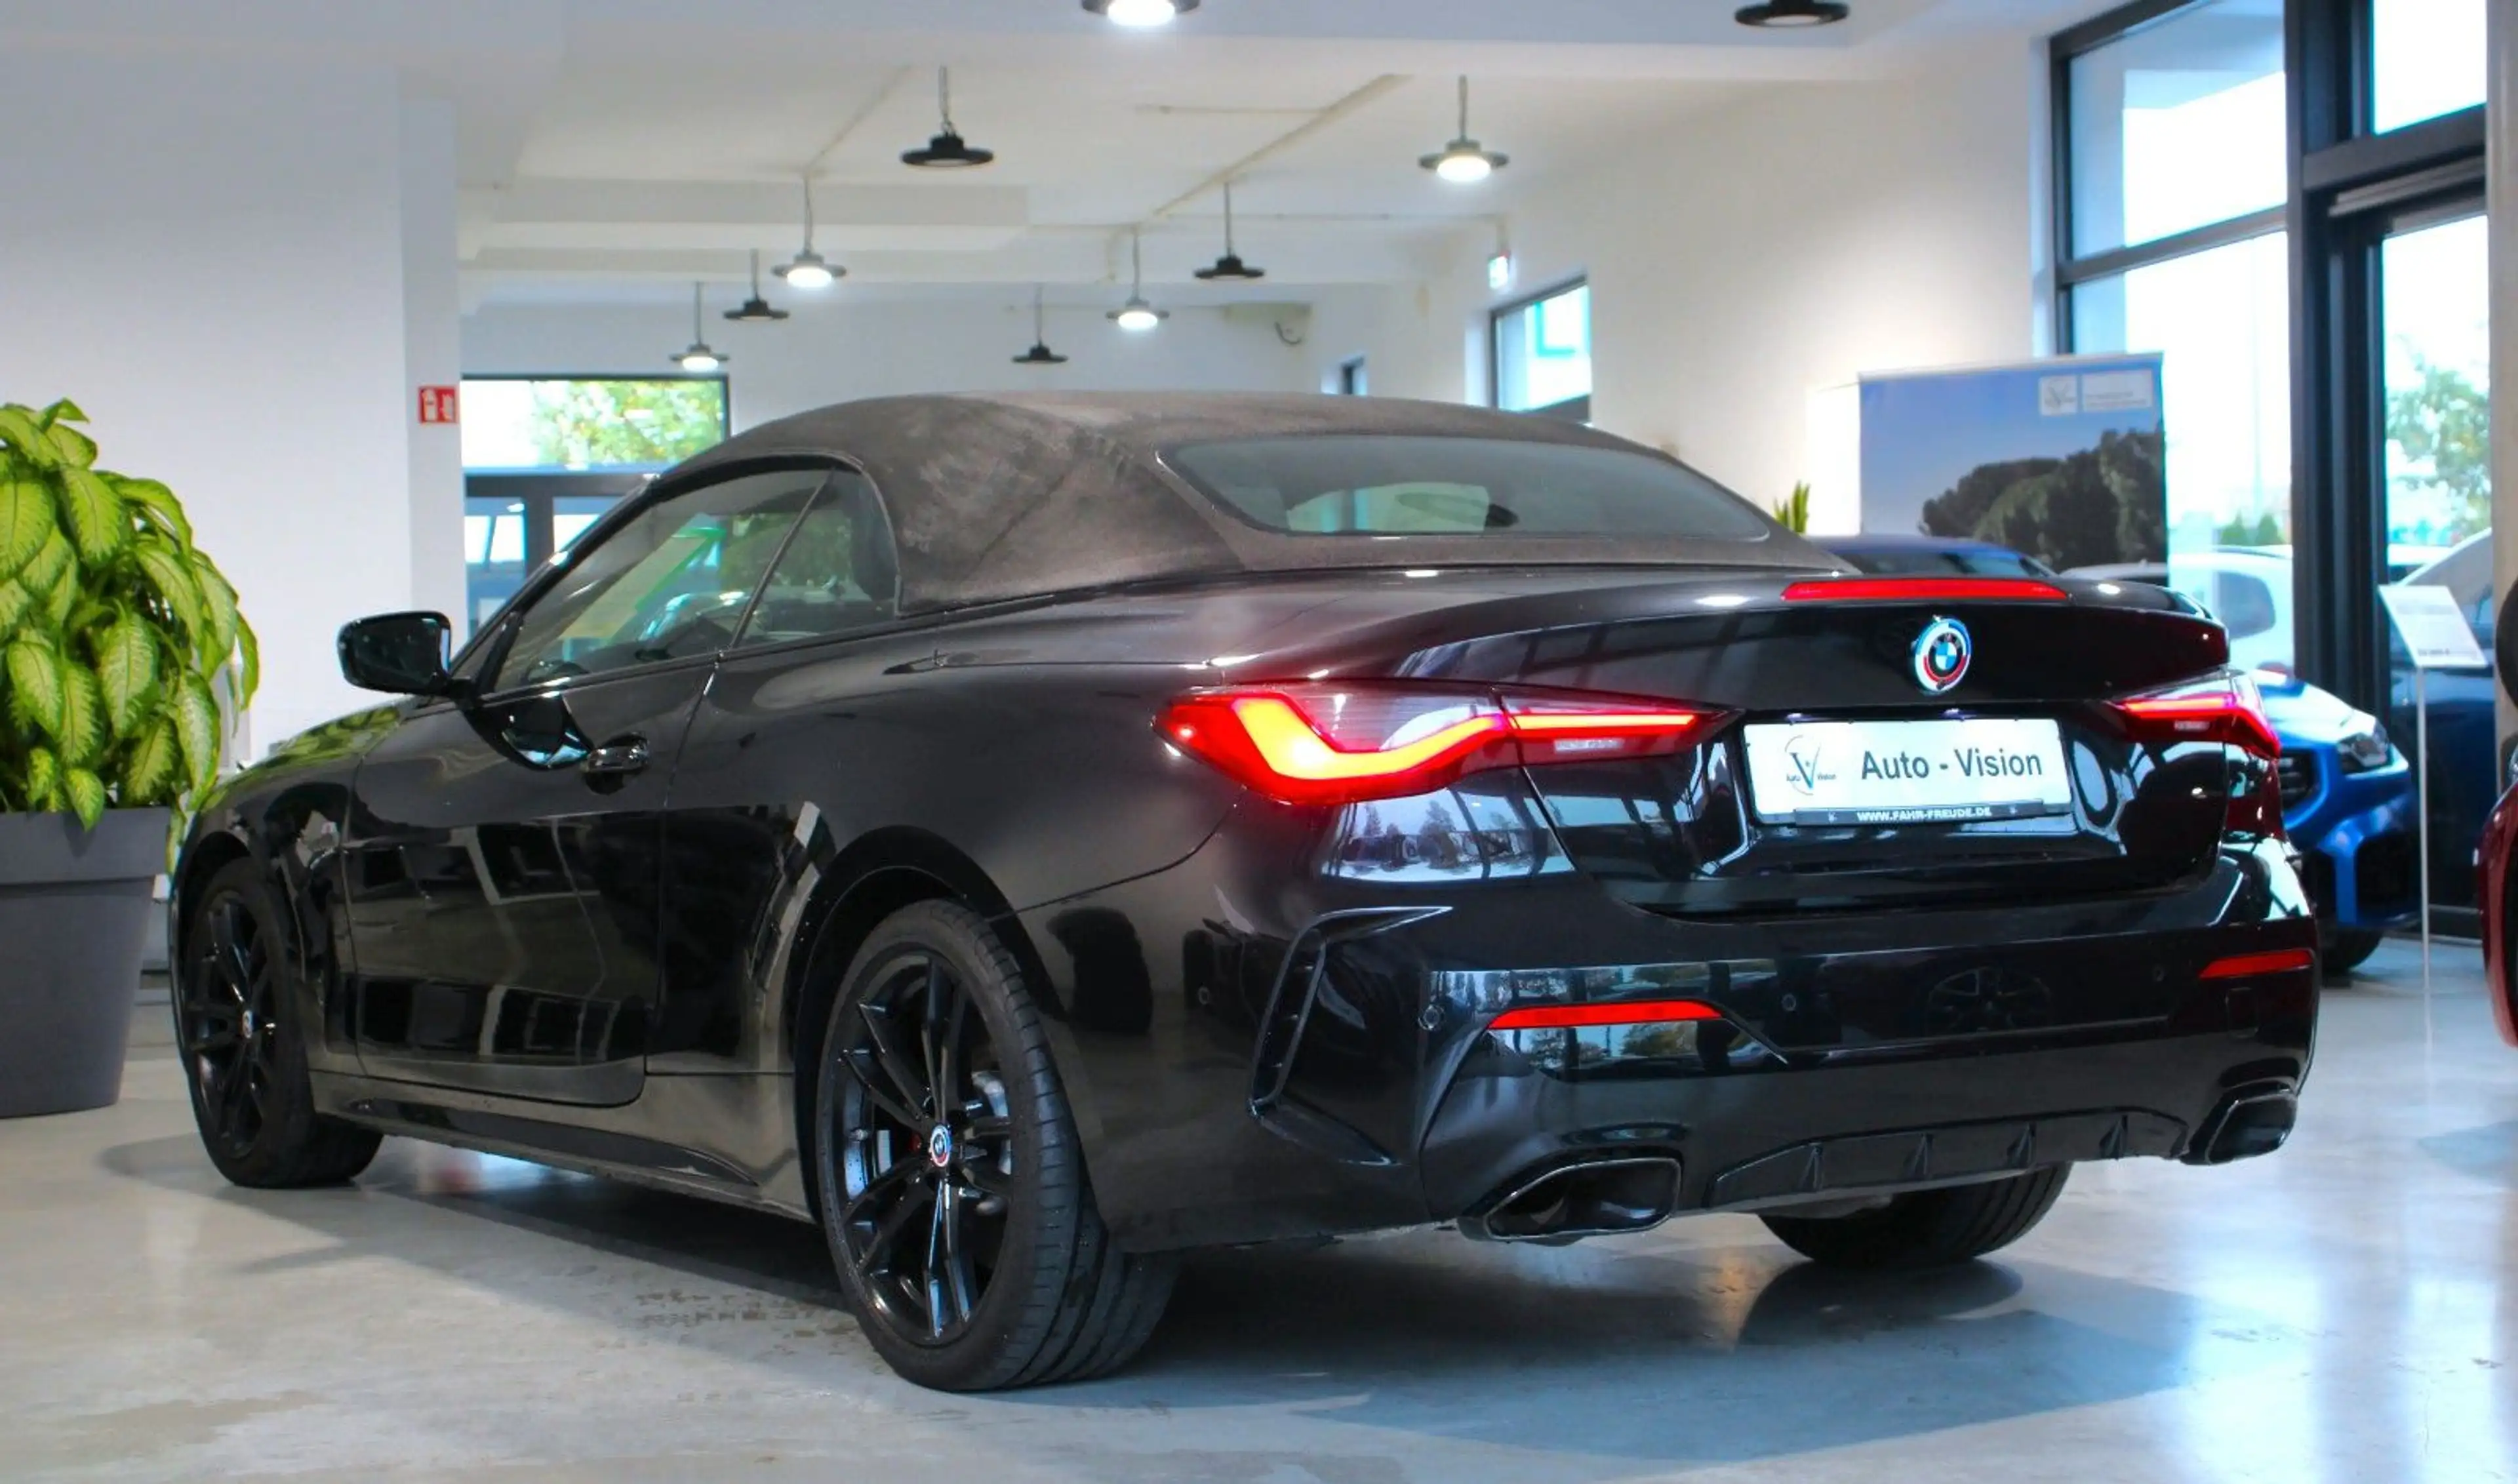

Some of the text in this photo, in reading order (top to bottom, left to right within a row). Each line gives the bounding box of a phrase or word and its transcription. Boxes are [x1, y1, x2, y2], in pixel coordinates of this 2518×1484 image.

[1861, 750, 1930, 780] Auto
[1953, 747, 2043, 777] Vision
[1856, 807, 1992, 822] WWW.FAHR-FREUDE.DE
